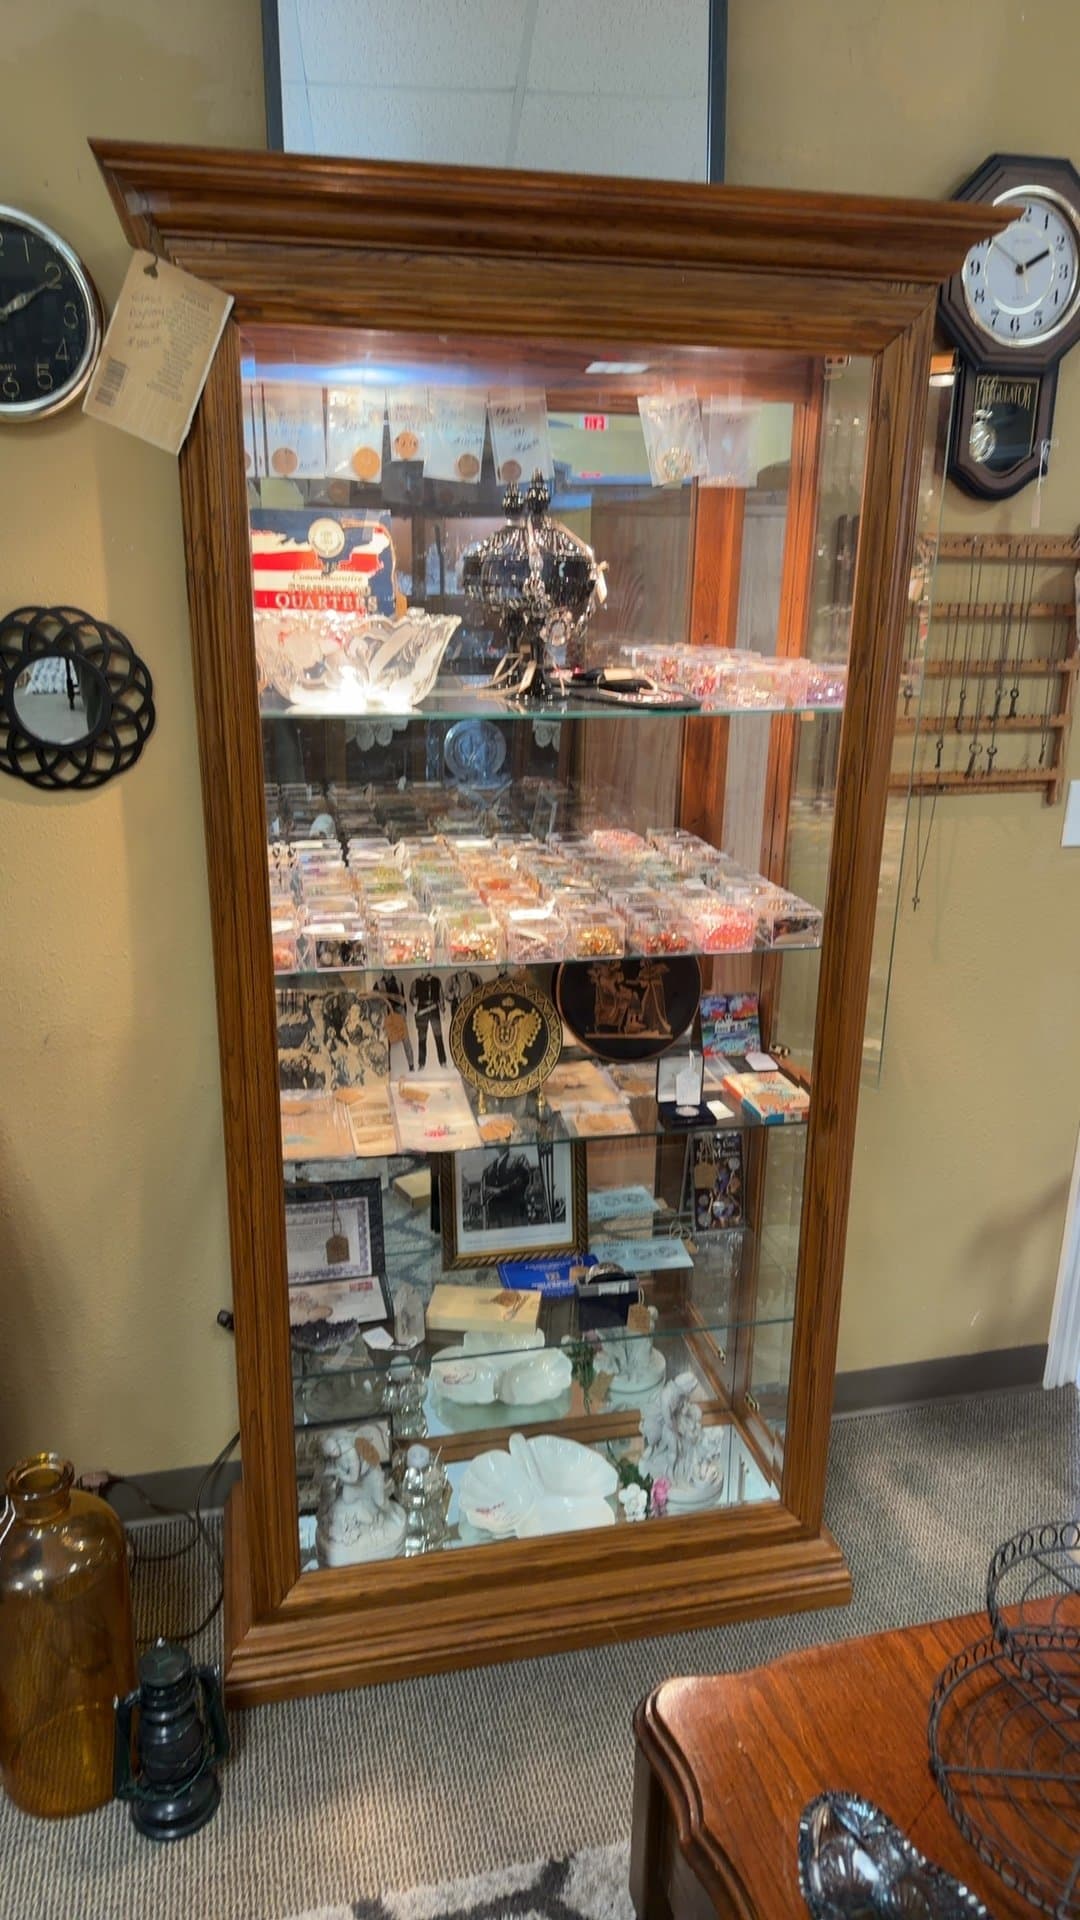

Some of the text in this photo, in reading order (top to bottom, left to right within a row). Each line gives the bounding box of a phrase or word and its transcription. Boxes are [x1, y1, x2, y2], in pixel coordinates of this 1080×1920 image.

[1044, 213, 1050, 231] 1
[23, 234, 31, 265] 1
[1055, 235, 1066, 251] 2
[44, 261, 63, 289] 2
[970, 259, 981, 276] 9
[1058, 263, 1069, 281] 3
[974, 287, 985, 305] 8
[63, 300, 79, 330] 3
[990, 309, 1000, 328] 7
[1009, 316, 1021, 333] 6
[1032, 310, 1044, 328] 5
[55, 336, 70, 361] 4
[2, 371, 20, 398] 6
[36, 362, 54, 391] 5
[275, 593, 378, 612] QUARTERS
